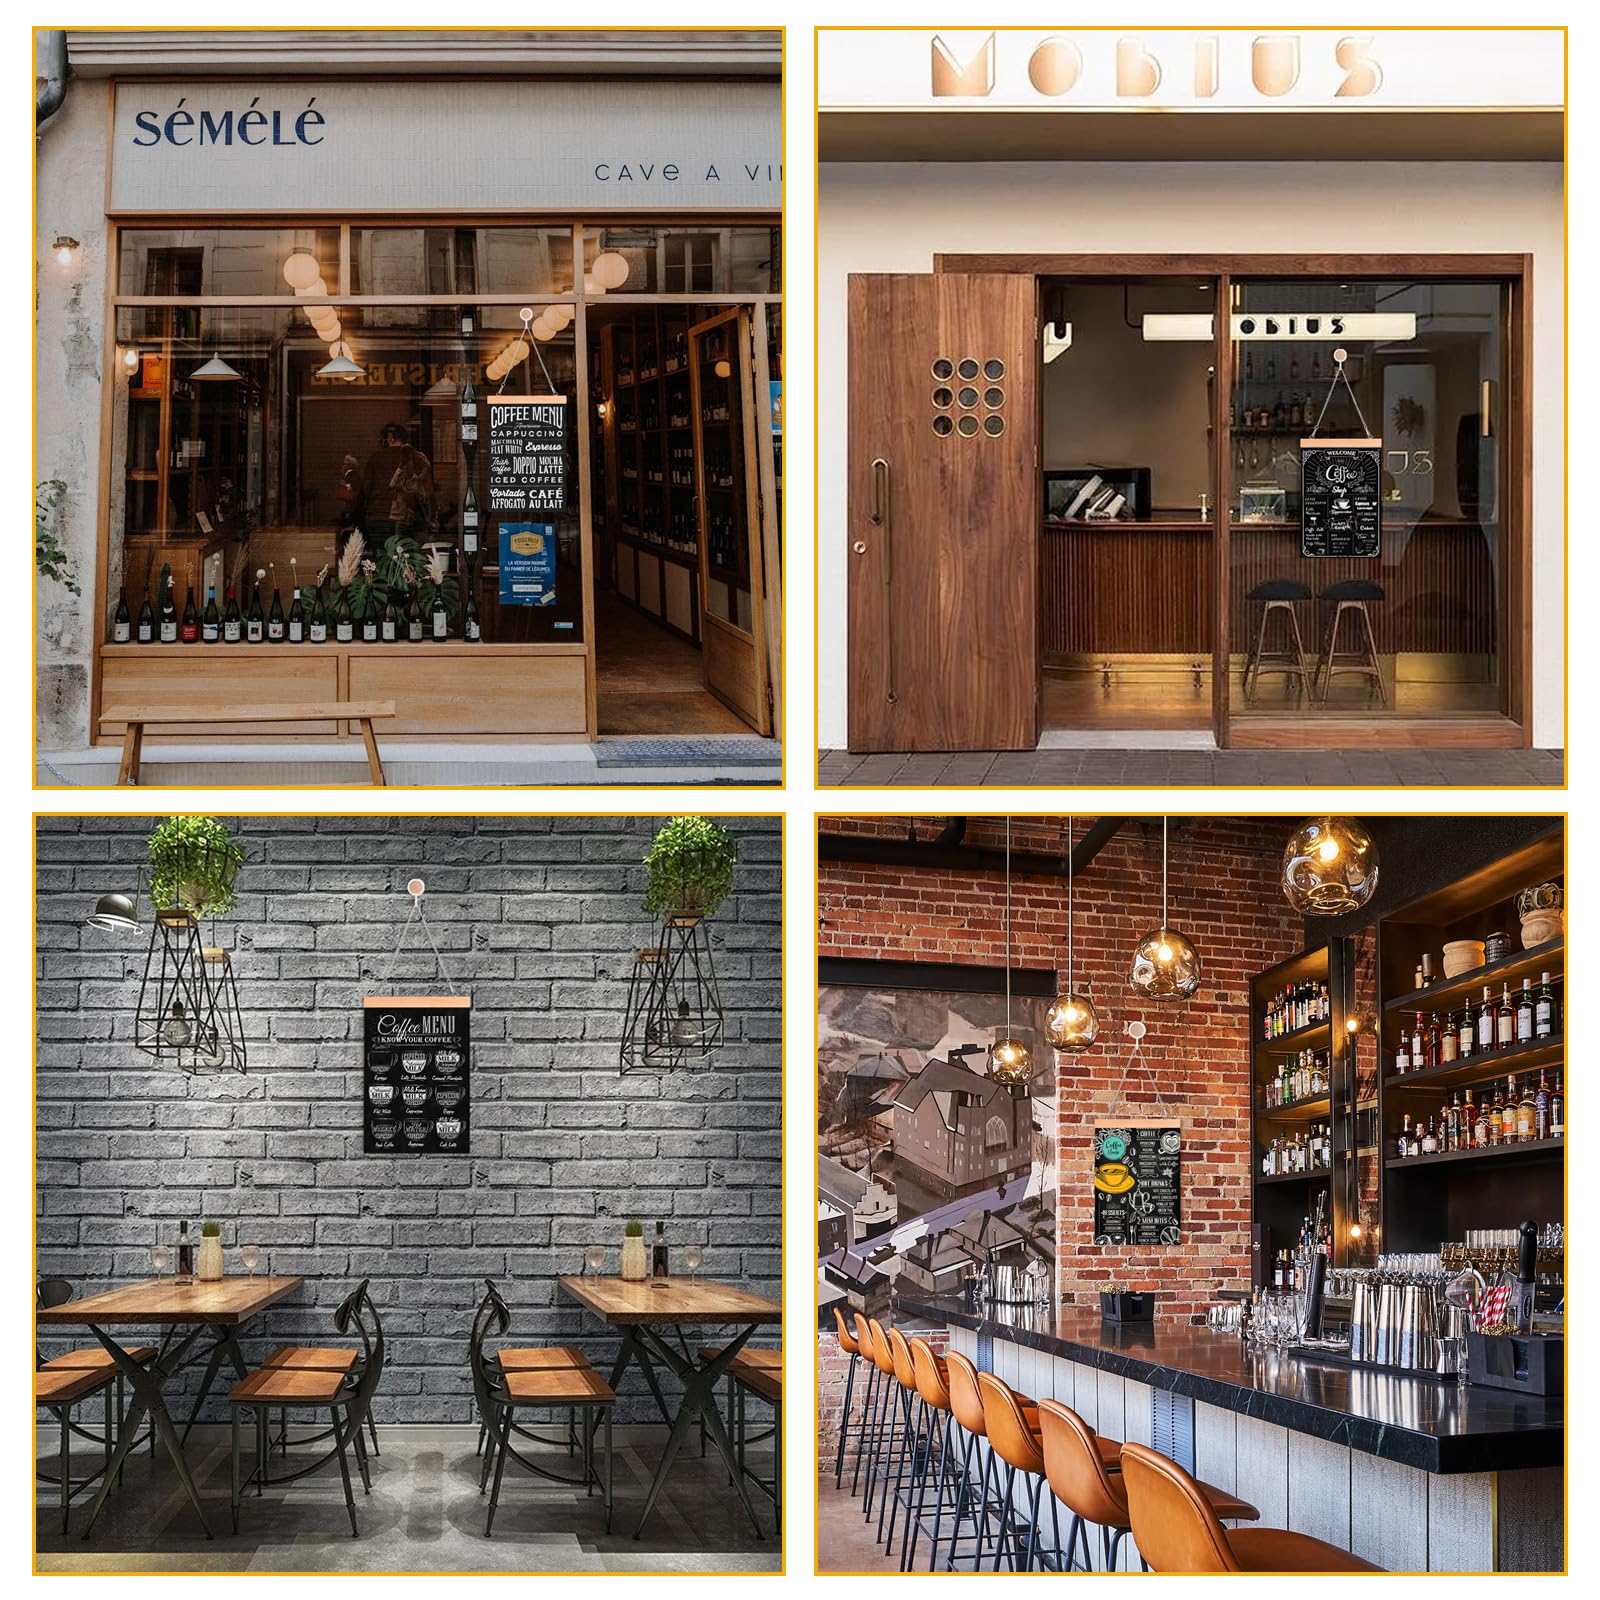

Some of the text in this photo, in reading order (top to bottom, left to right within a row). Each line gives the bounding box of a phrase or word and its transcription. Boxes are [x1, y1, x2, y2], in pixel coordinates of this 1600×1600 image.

[931, 32, 1384, 97] MOBIUS
[705, 164, 720, 181] A
[1211, 315, 1345, 335] OBIUS
[491, 406, 563, 429] COFFEE MENU
[525, 441, 562, 452] Espresso
[513, 456, 537, 474] DOPPIO
[539, 456, 563, 465] MOCHA
[539, 465, 563, 474] LATTE
[1325, 464, 1358, 484] Coffee
[521, 476, 563, 484] COFFEE
[490, 487, 563, 499] Cortado CAFÉ
[1331, 485, 1348, 498] Shop
[491, 498, 563, 509] AFFOGATO AU LAIT
[377, 1014, 456, 1040] Coffee MENU
